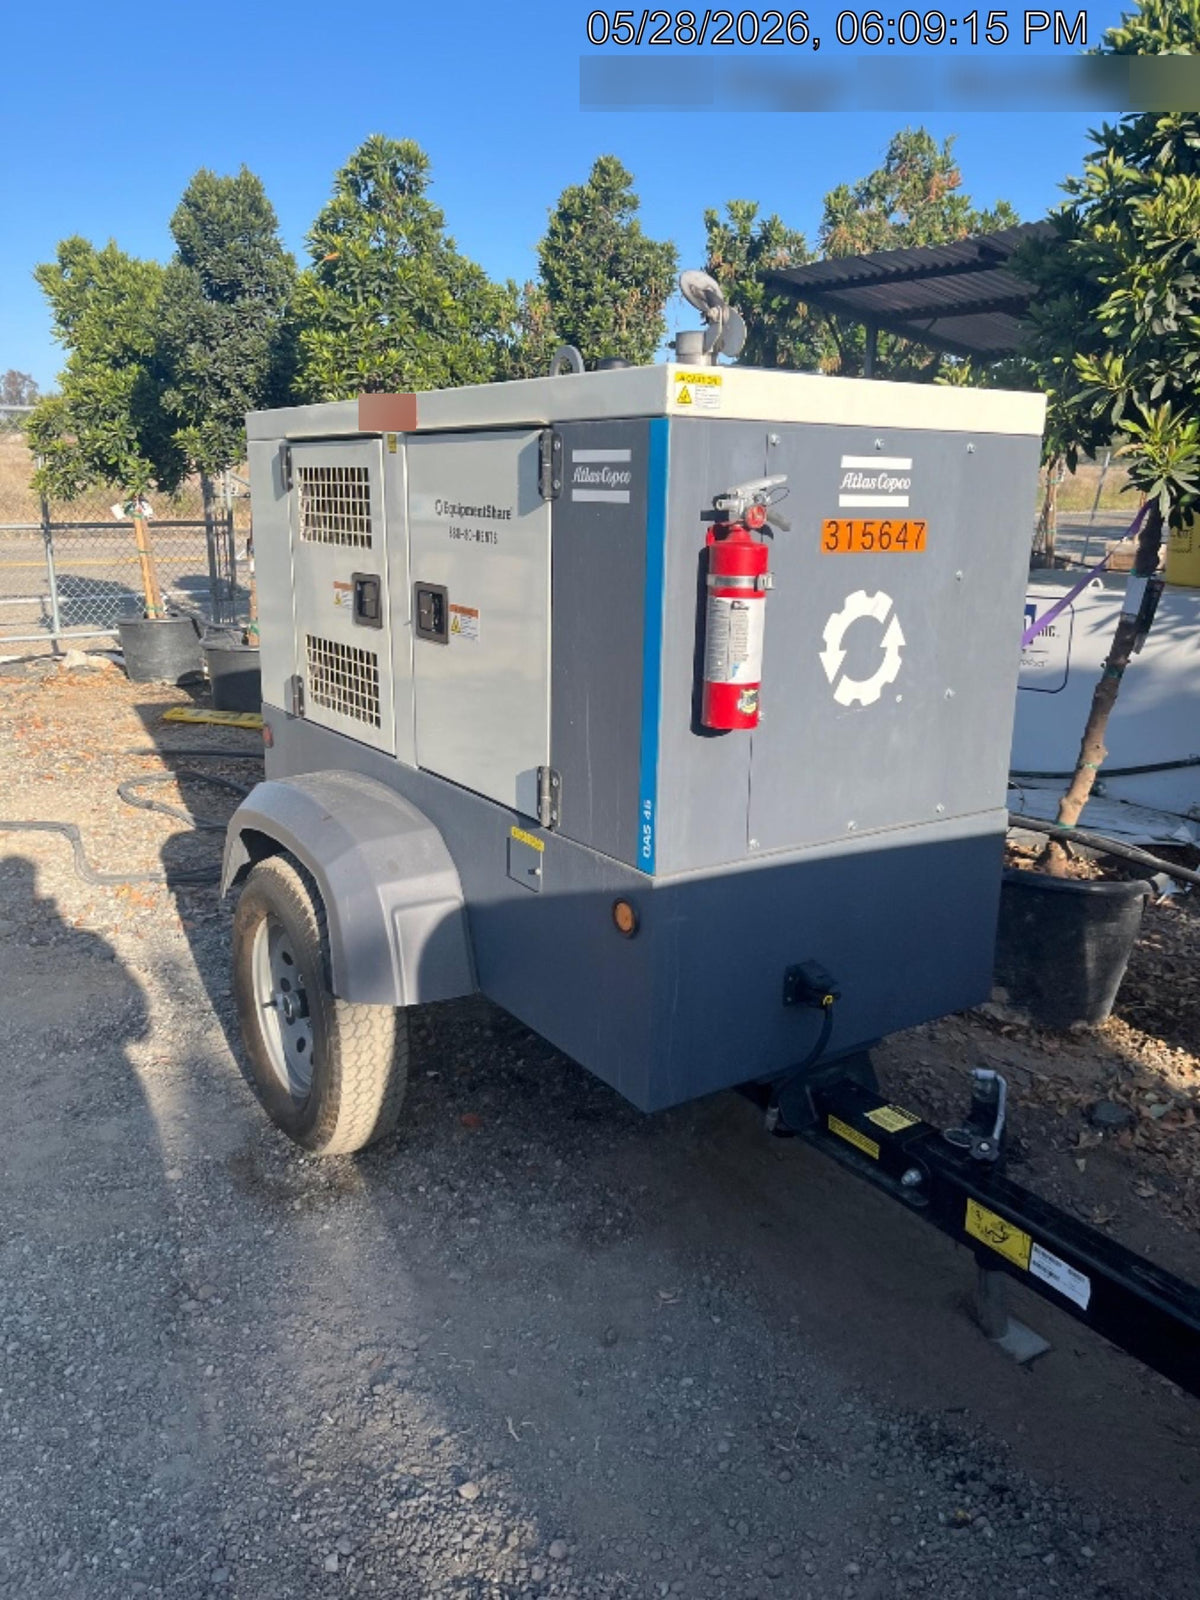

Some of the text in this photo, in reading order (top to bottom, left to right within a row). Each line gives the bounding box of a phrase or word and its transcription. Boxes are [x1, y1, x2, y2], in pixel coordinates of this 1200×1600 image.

[572, 466, 631, 488] Atlas Copco
[840, 472, 911, 493] Atlas Copco
[824, 520, 926, 551] 315647
